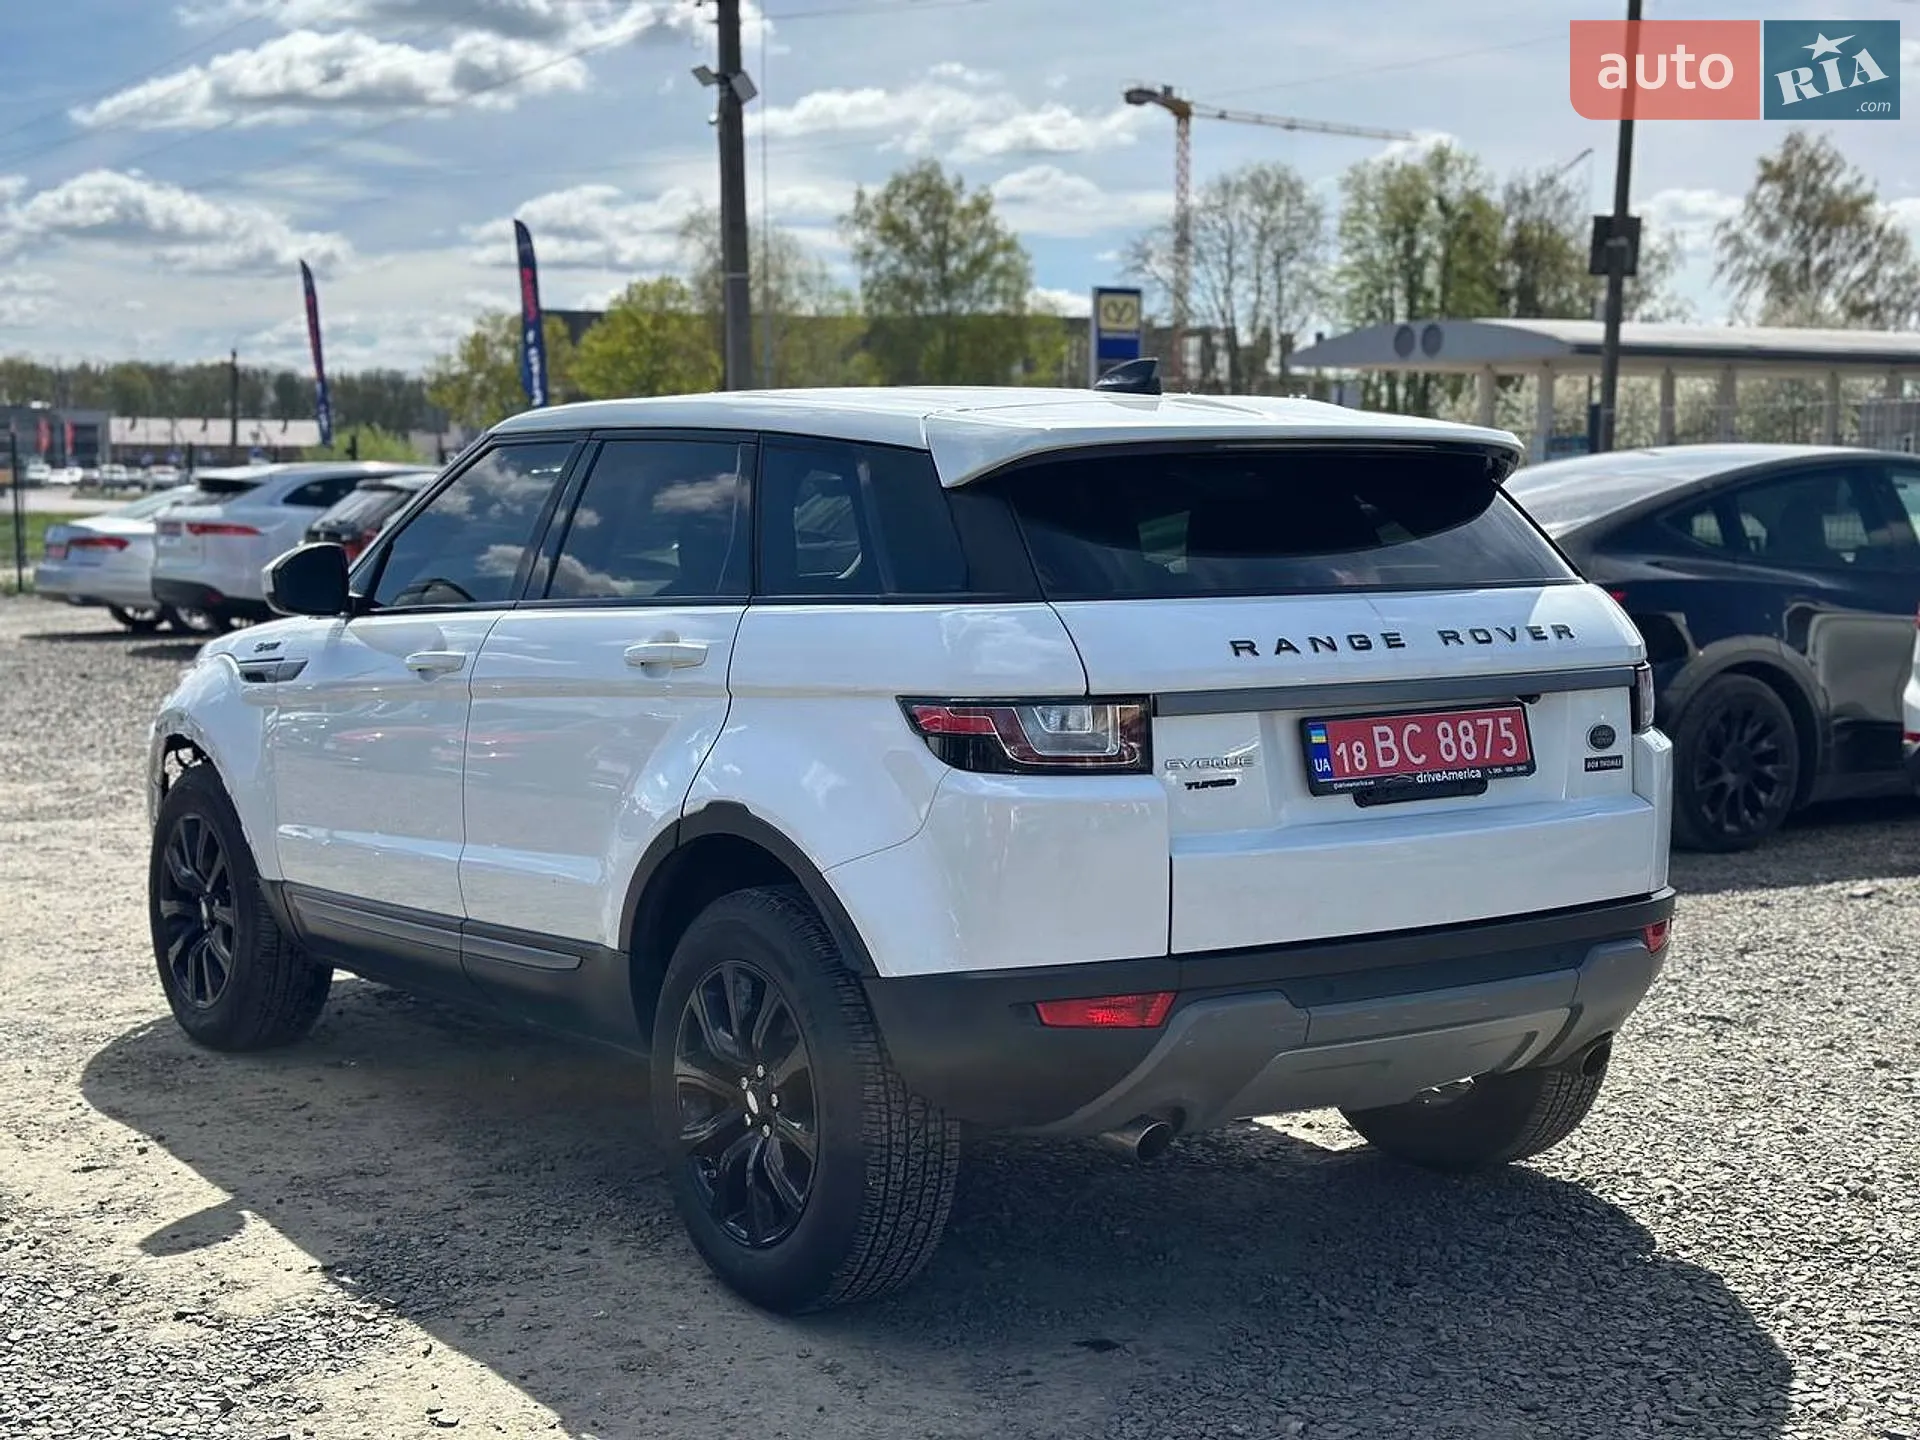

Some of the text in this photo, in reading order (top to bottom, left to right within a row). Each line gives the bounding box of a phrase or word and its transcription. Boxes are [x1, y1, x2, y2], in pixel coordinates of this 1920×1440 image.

[1229, 623, 1576, 657] RANGE ROVER
[1335, 716, 1518, 773] 18 BC 8875
[1164, 756, 1255, 771] EVOQUE
[1314, 758, 1331, 772] UA
[1416, 767, 1482, 784] driveAmerica
